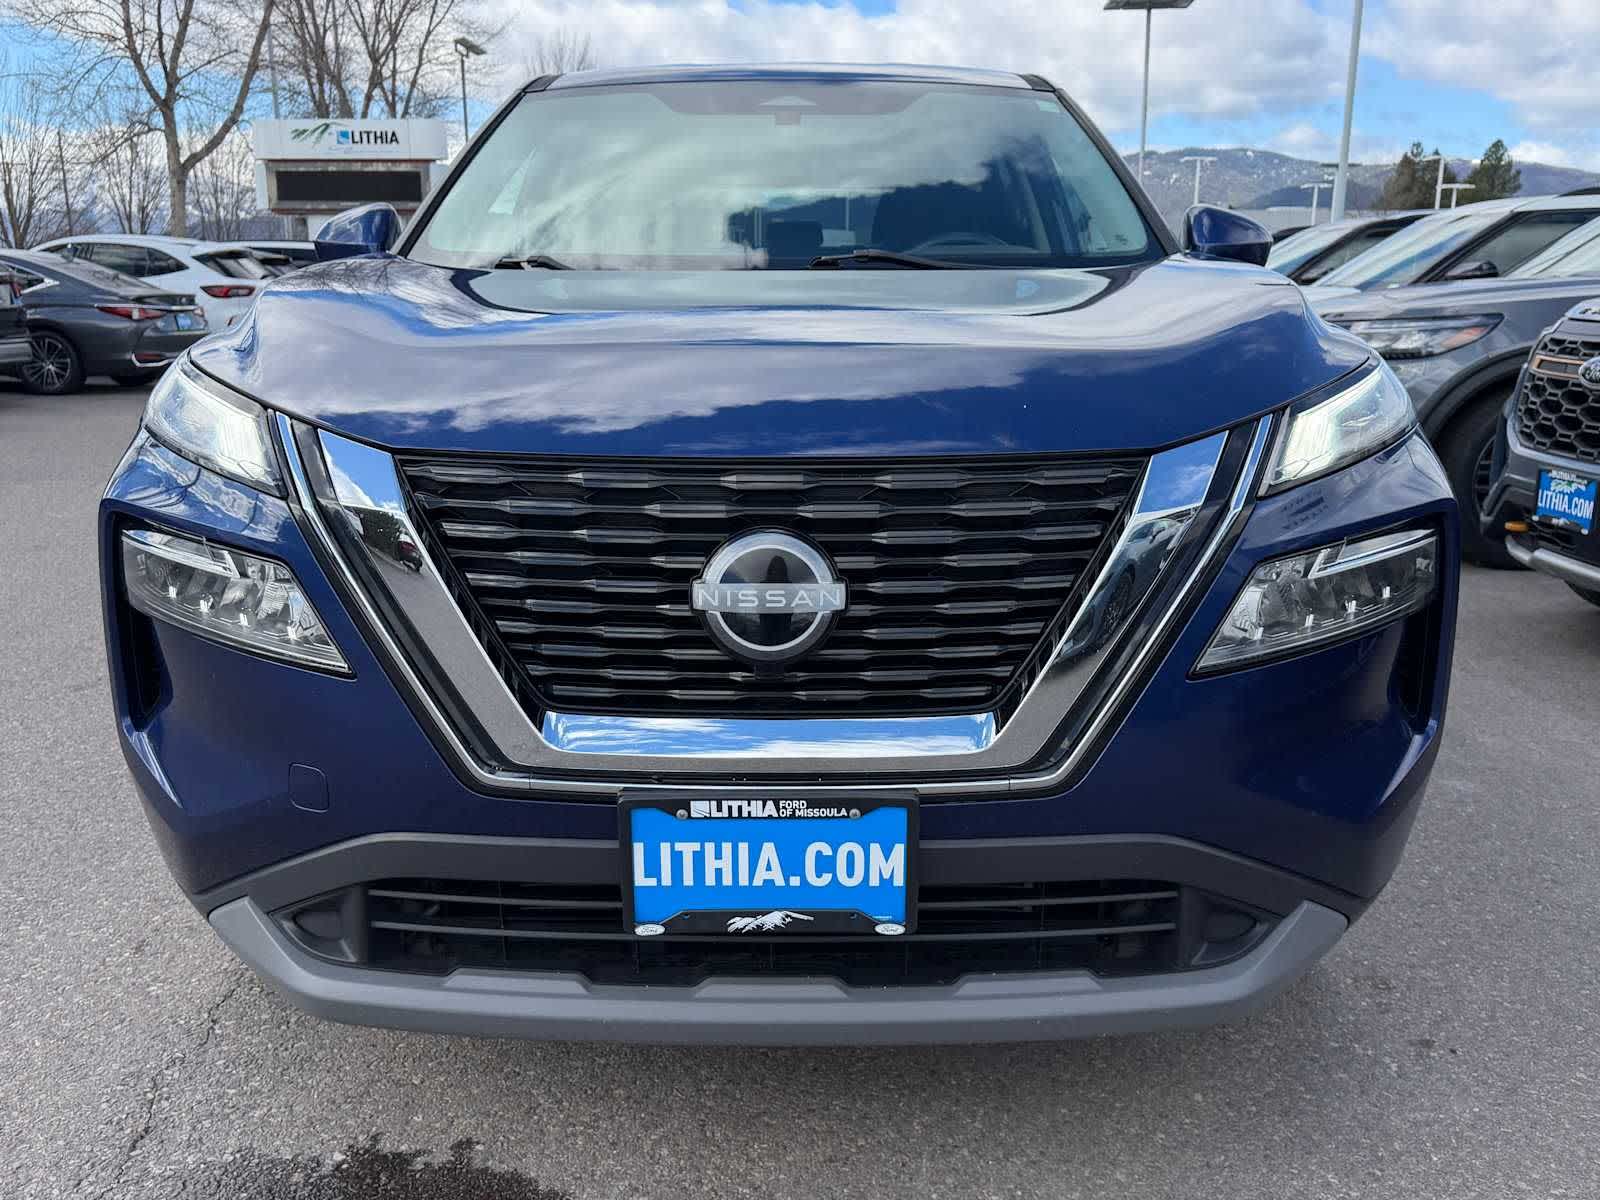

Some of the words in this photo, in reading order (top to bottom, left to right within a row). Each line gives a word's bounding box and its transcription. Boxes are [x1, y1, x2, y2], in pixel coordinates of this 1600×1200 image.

[351, 130, 399, 145] LITHIA
[1538, 489, 1594, 520] LITHIA.COM
[698, 589, 841, 607] NISSAN
[710, 800, 779, 818] LITHIA
[779, 800, 807, 809] FORD
[779, 808, 793, 817] OF
[795, 807, 848, 817] MISSOULA
[632, 841, 906, 887] LITHIA.COM
